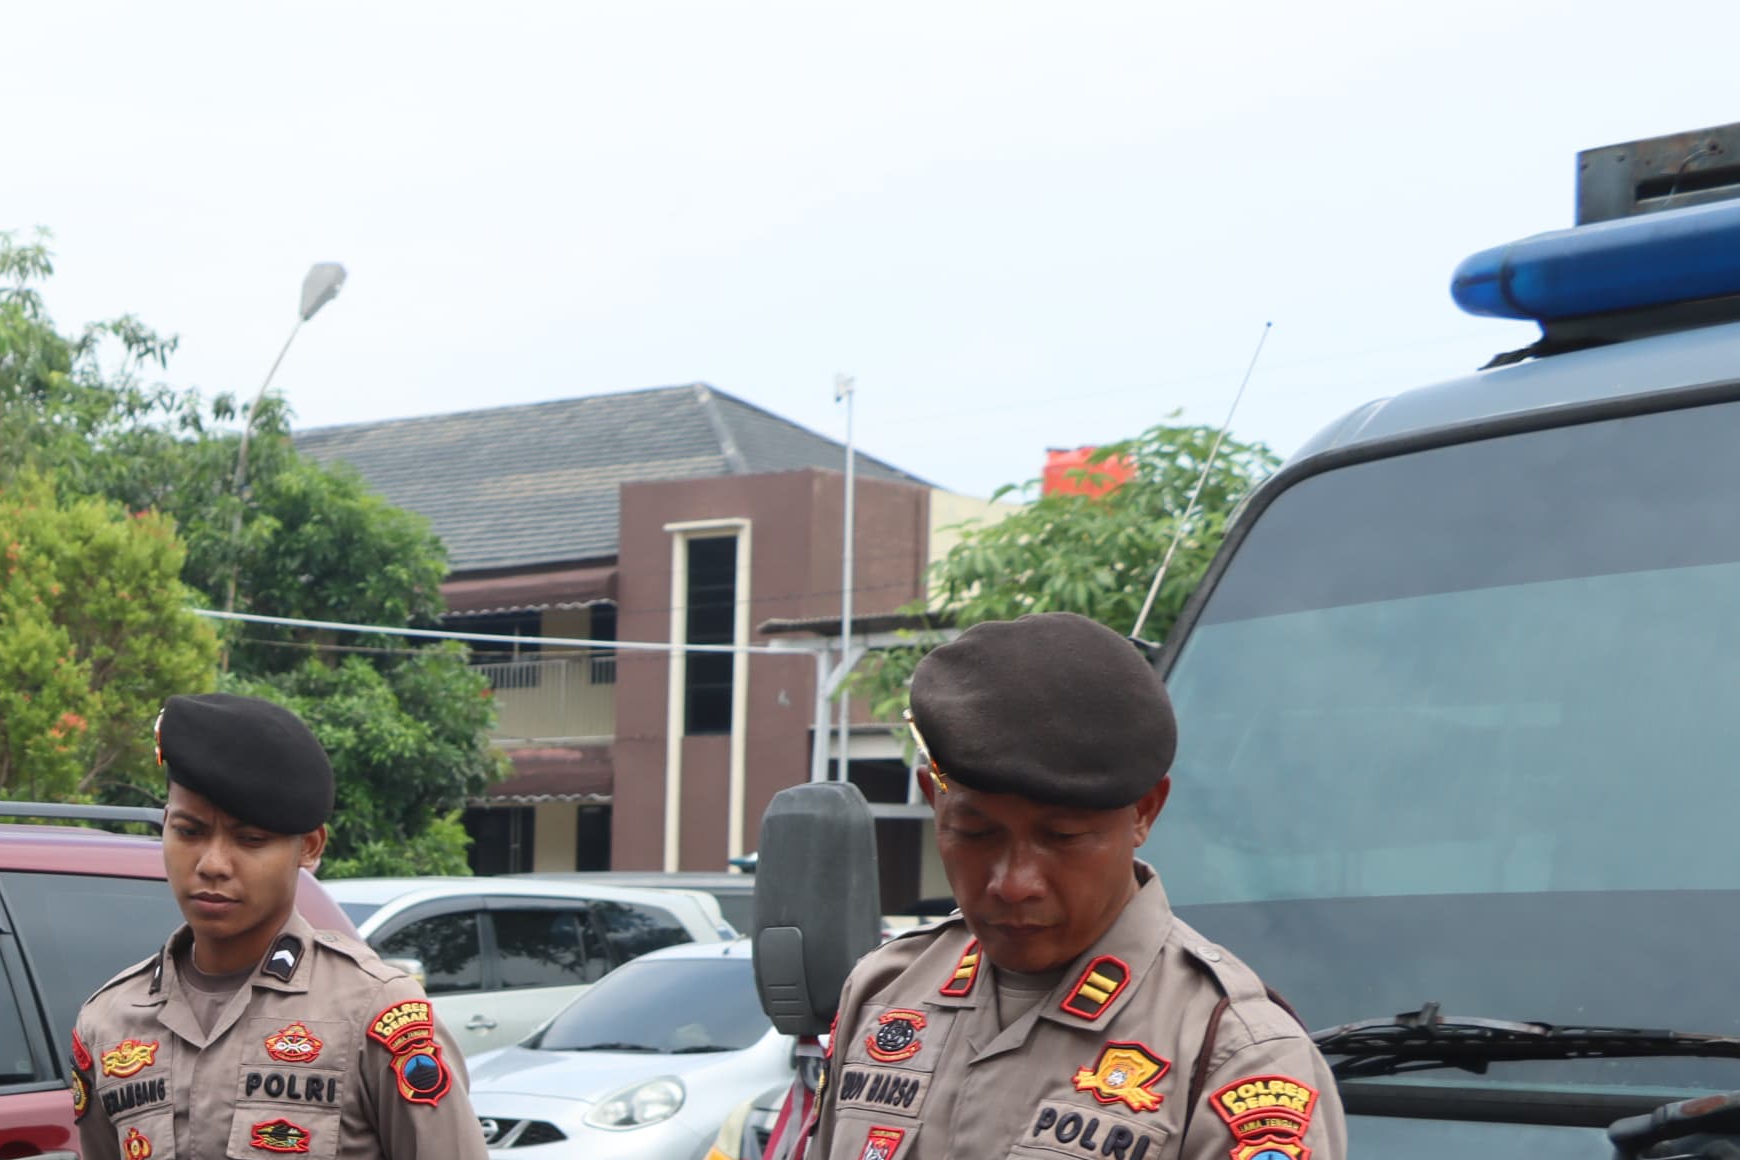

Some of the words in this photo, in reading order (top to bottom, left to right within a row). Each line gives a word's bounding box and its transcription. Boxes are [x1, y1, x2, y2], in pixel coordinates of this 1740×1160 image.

[374, 1002, 429, 1033] POLRES
[383, 1011, 429, 1036] DEMAK
[245, 1071, 336, 1103] POLRI
[1221, 1080, 1311, 1108] POLRES
[1232, 1094, 1306, 1115] DEMAK
